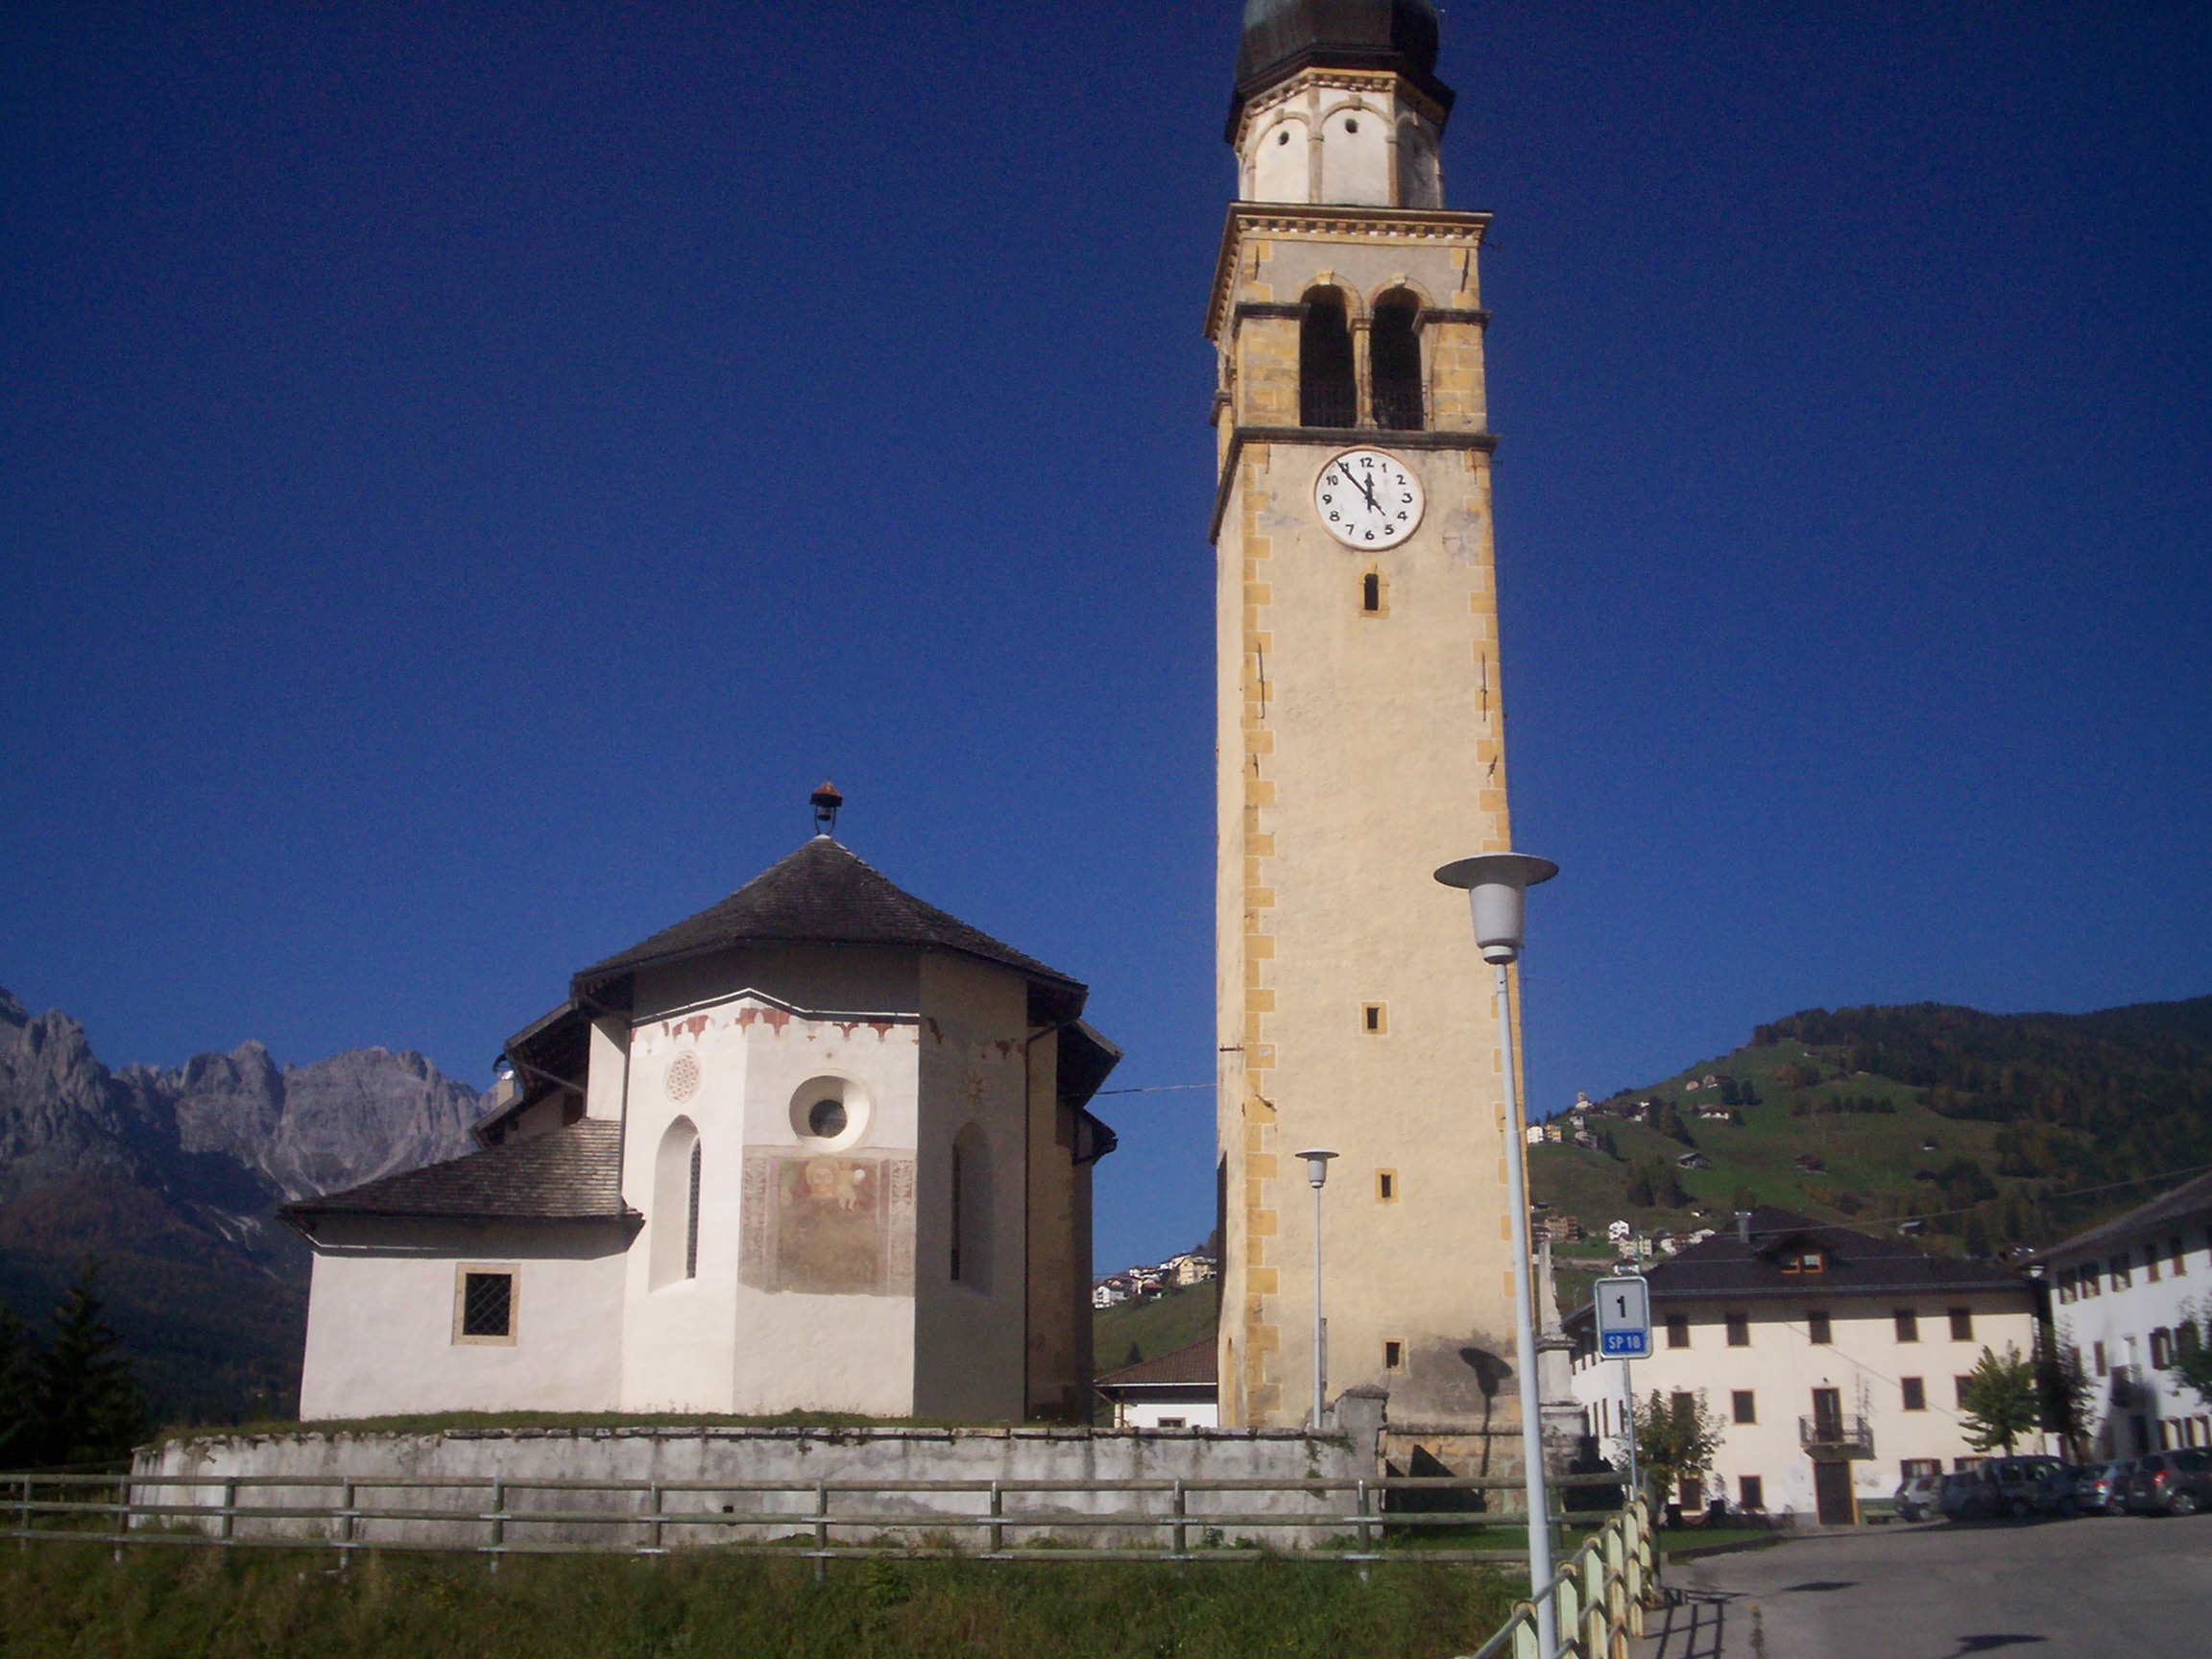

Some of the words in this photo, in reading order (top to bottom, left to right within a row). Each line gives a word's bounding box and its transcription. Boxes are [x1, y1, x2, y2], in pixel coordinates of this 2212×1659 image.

[1359, 457, 1374, 468] 12
[1382, 463, 1387, 473] 1
[1326, 475, 1338, 486] 10
[1396, 474, 1406, 485] 2
[1322, 493, 1332, 505] 9
[1401, 493, 1412, 503] 3
[1330, 511, 1340, 521] 8
[1397, 511, 1408, 521] 4
[1345, 524, 1354, 535] 7
[1384, 524, 1394, 535] 5
[1365, 530, 1375, 541] 6
[1617, 1295, 1626, 1318] 1
[1609, 1335, 1623, 1349] SP
[1627, 1335, 1641, 1349] 18
